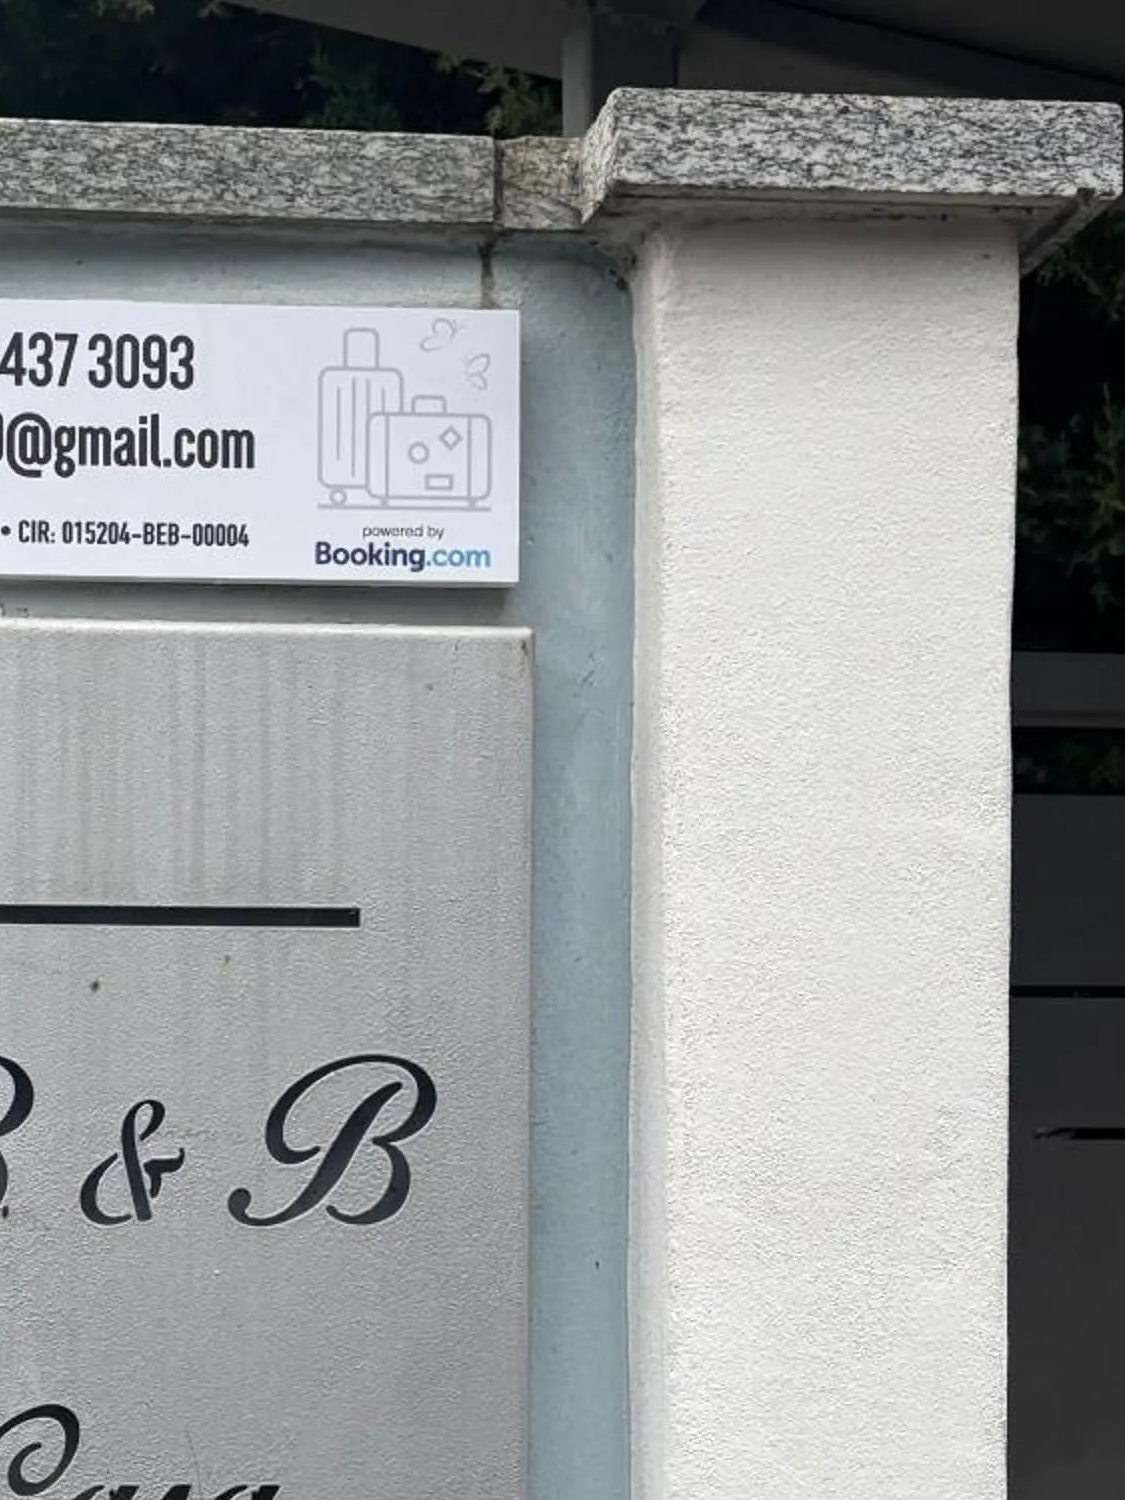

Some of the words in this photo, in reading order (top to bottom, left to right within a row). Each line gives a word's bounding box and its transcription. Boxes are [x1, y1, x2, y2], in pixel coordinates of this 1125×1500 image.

[88, 333, 195, 391] 3093
[18, 519, 56, 544] CIR:
[61, 520, 250, 548] 015204-BEB-00004
[362, 524, 424, 539] powered
[427, 525, 445, 540] by
[315, 541, 492, 573] Booking.com
[79, 1098, 186, 1226] &
[227, 1053, 439, 1227] B
